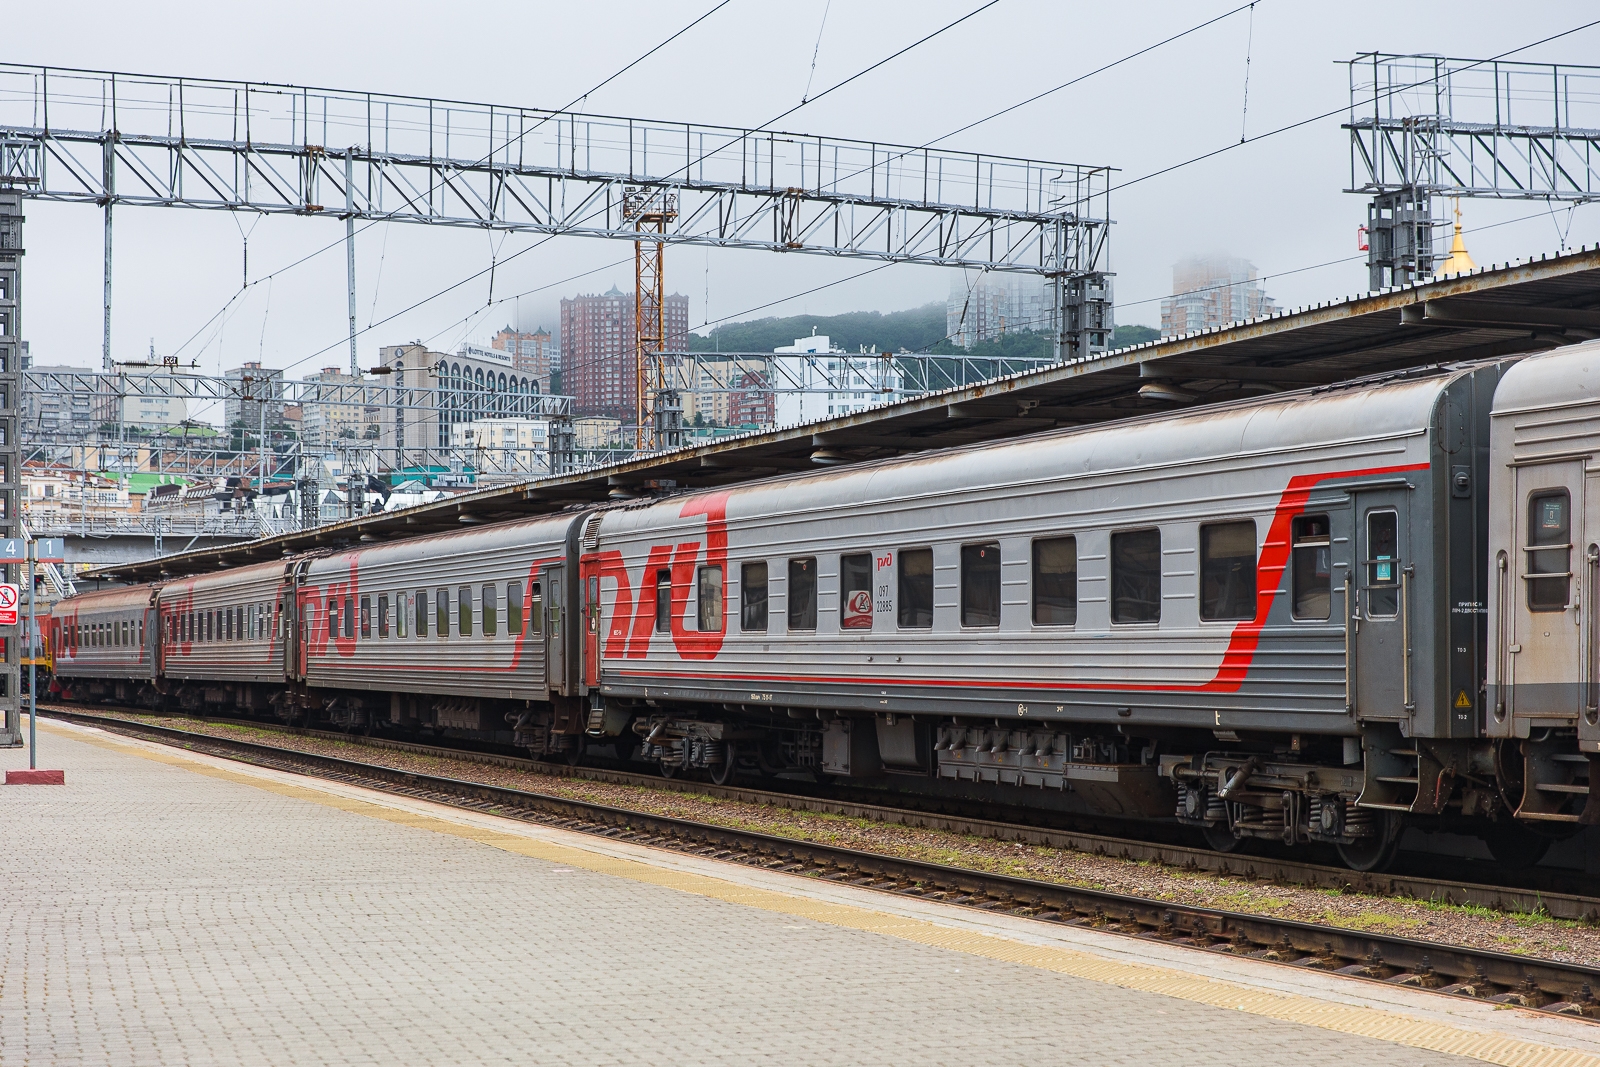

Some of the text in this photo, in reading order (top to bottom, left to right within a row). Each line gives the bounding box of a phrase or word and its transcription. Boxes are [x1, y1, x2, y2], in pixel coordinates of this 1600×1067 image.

[5, 540, 17, 555] 4
[45, 540, 53, 555] 1
[878, 585, 889, 598] 097
